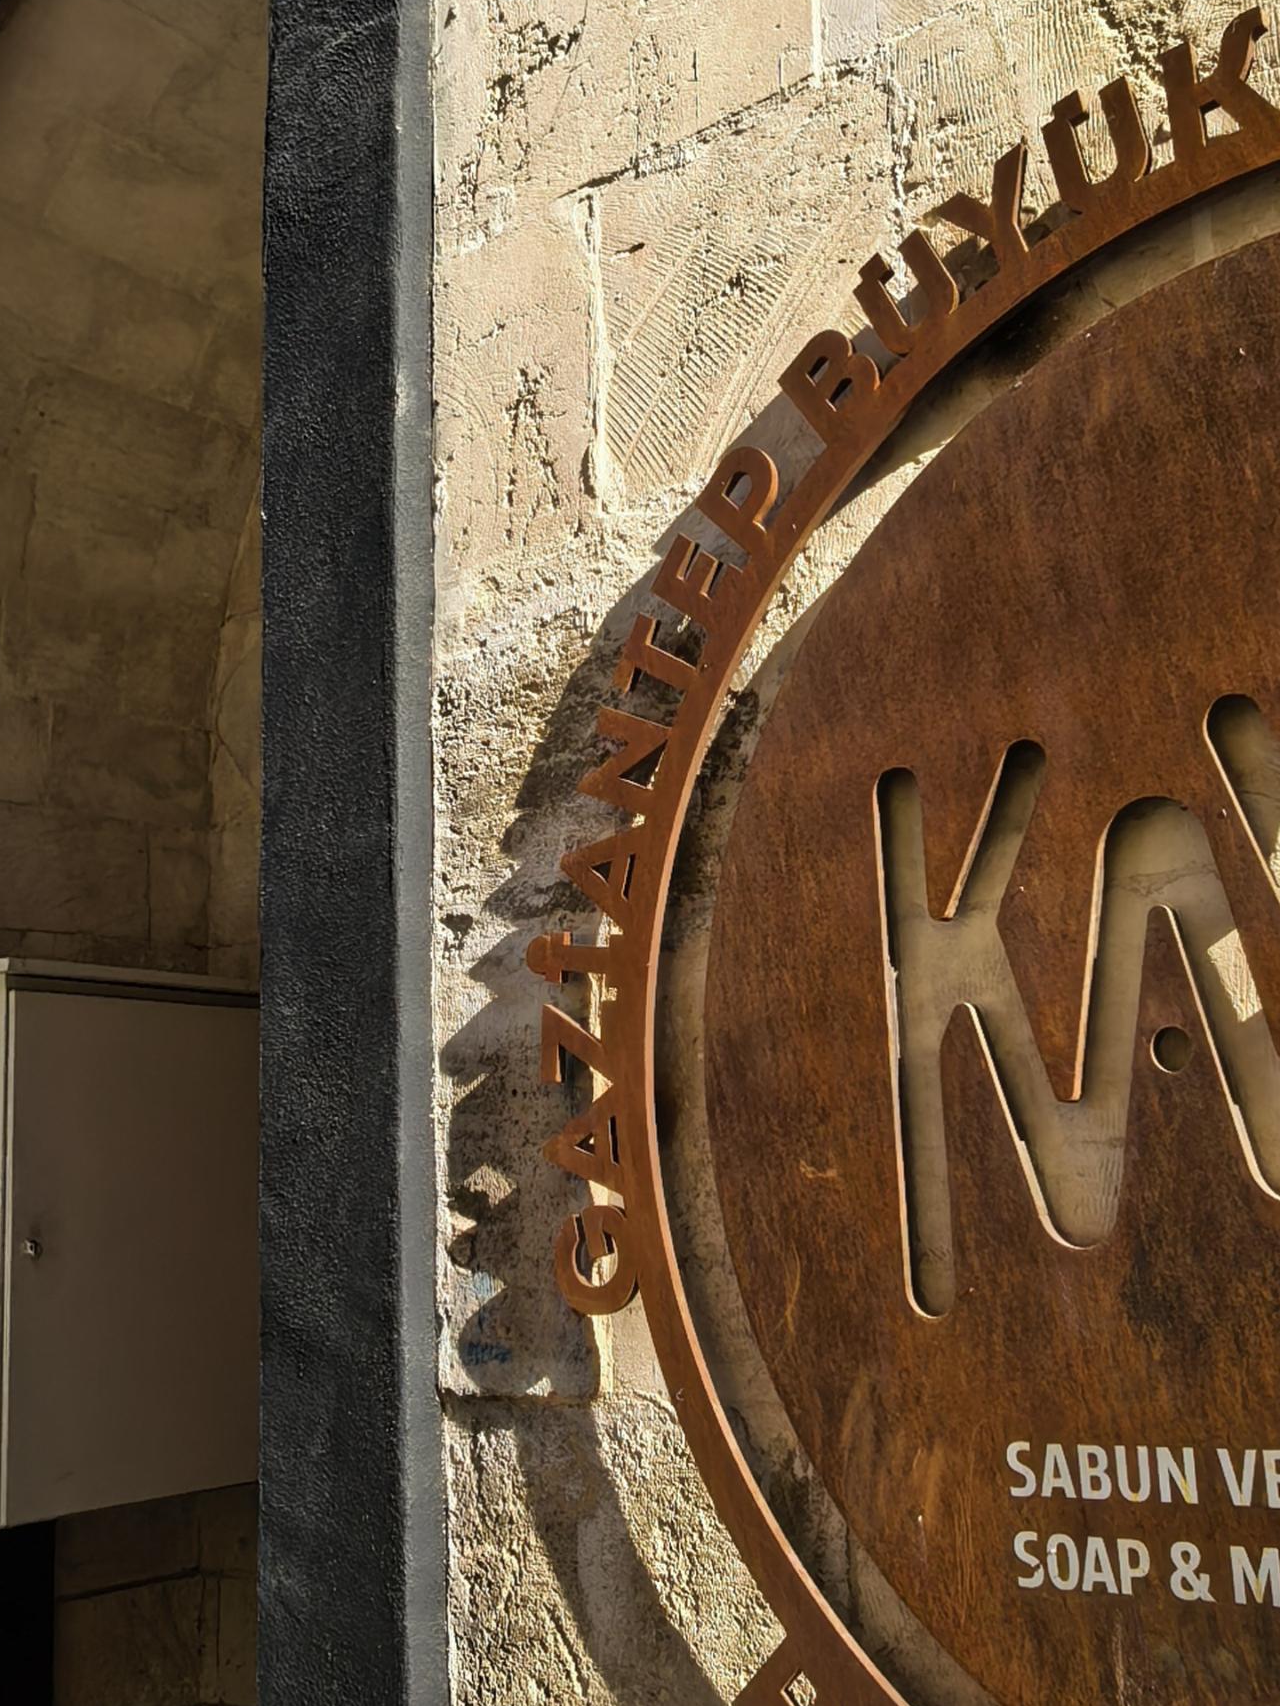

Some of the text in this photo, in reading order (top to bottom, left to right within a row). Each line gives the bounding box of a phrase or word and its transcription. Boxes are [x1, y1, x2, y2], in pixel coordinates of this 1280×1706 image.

[526, 446, 780, 1316] GAZİANTEP
[1006, 1441, 1198, 1504] SABUN
[1013, 1530, 1151, 1595] SOAP
[1170, 1541, 1216, 1603] &
